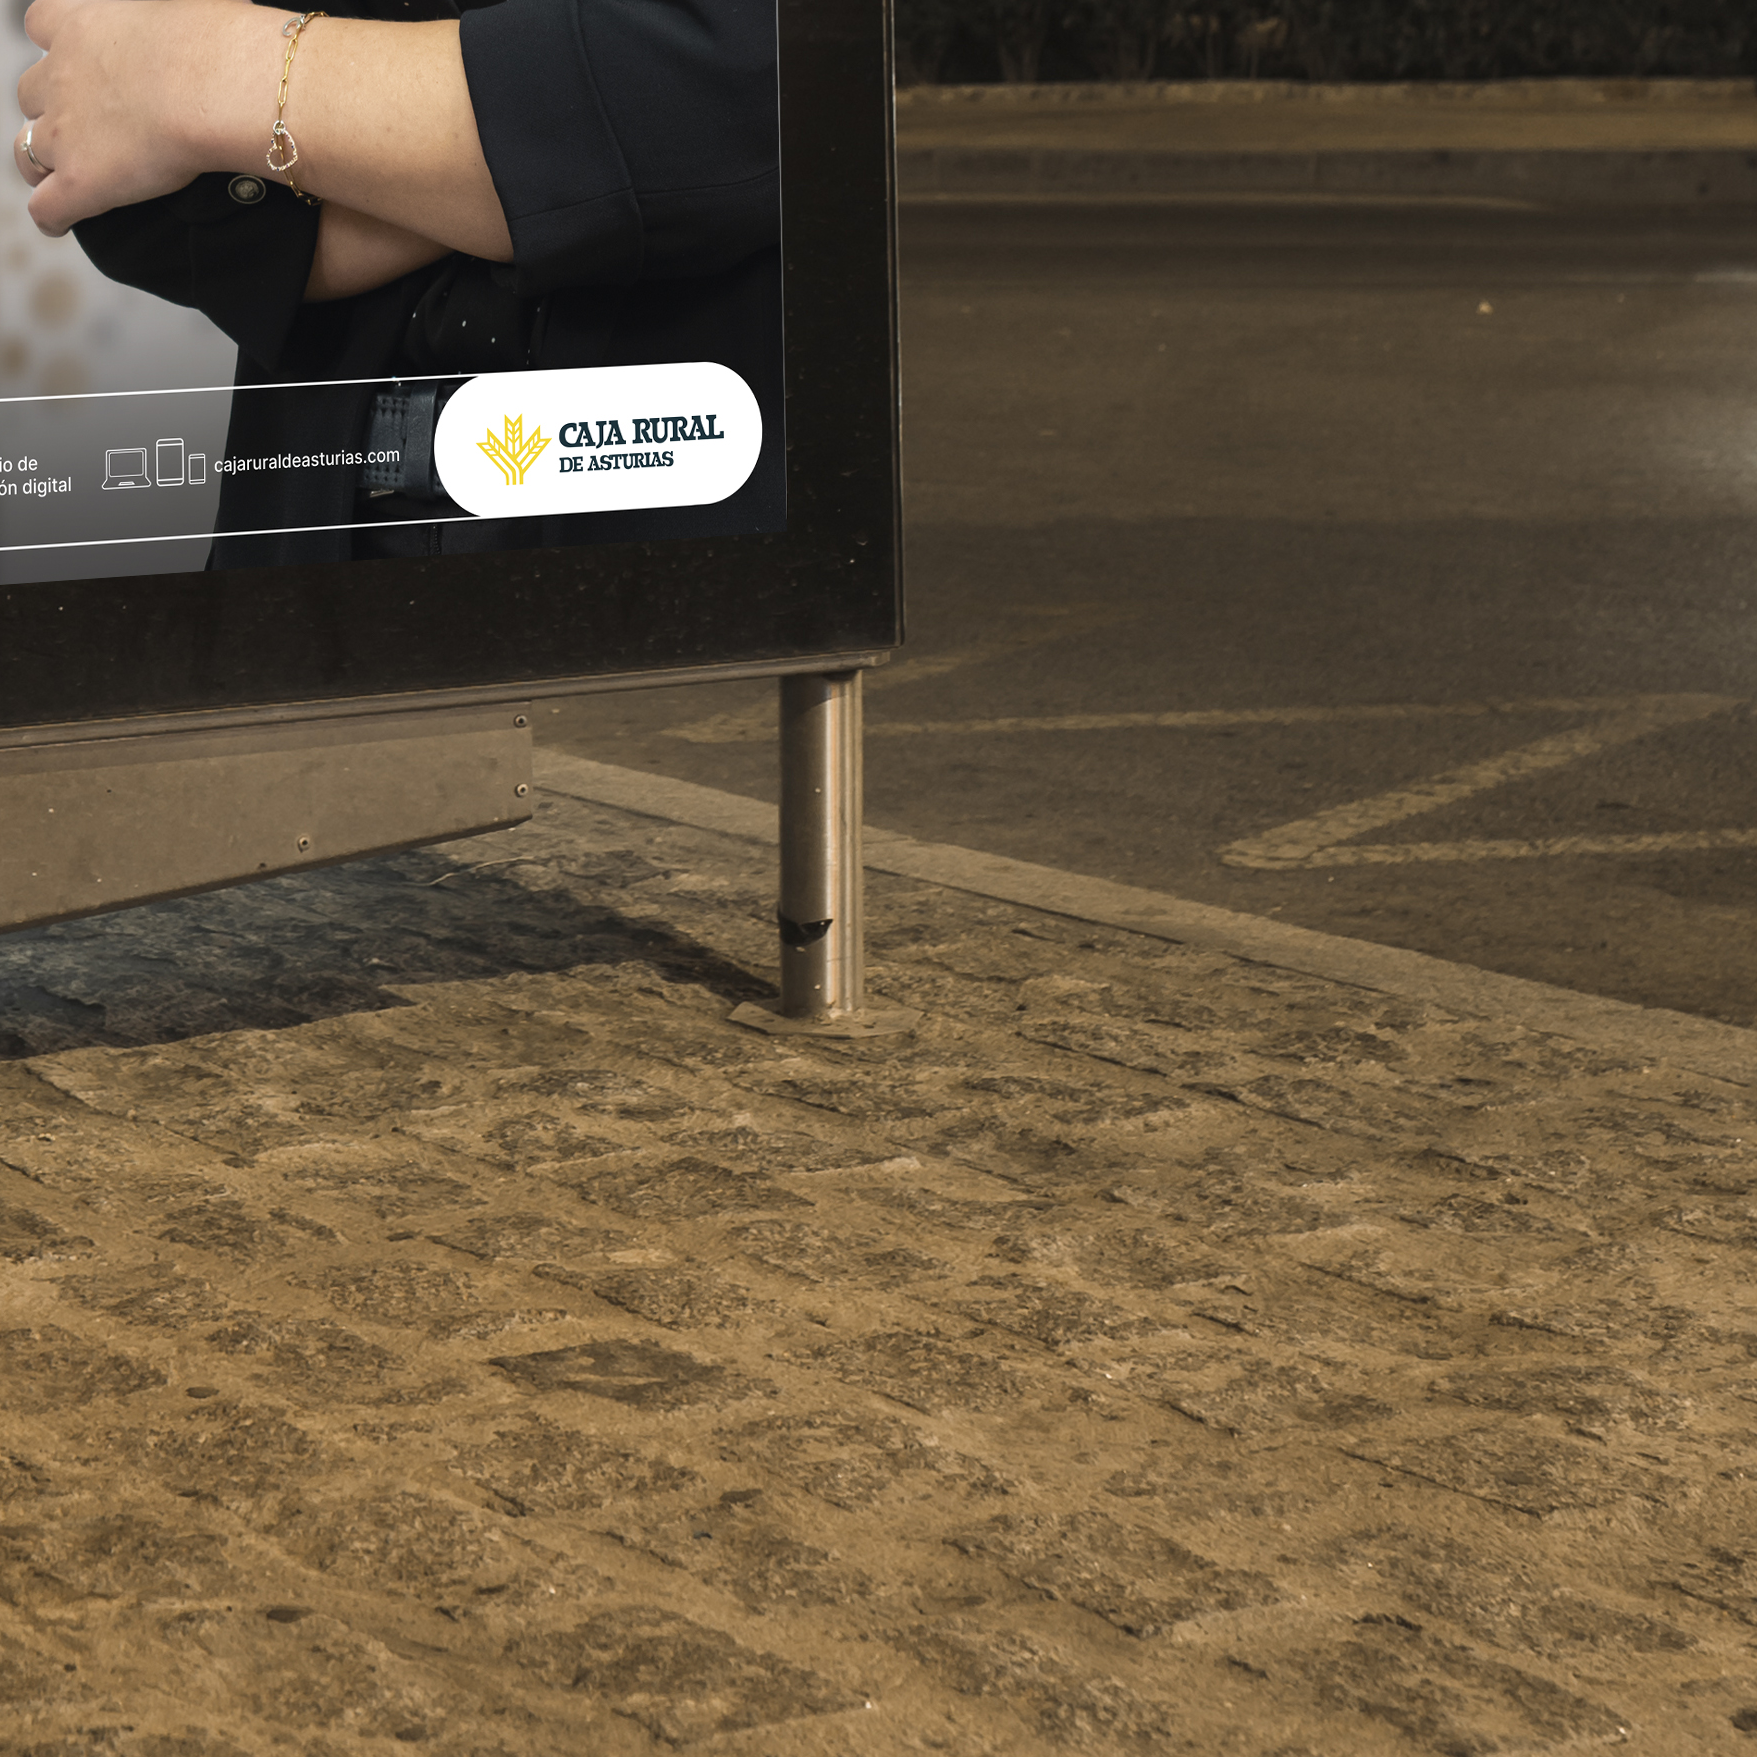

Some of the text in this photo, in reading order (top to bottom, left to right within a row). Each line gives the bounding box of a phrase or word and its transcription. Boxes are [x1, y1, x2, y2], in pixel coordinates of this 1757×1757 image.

[558, 414, 725, 449] CAJA RURAL
[17, 455, 38, 472] de
[214, 448, 400, 476] cajaruraldeasturias.com
[558, 450, 674, 473] DE ASTURIAS
[22, 476, 72, 498] digital
